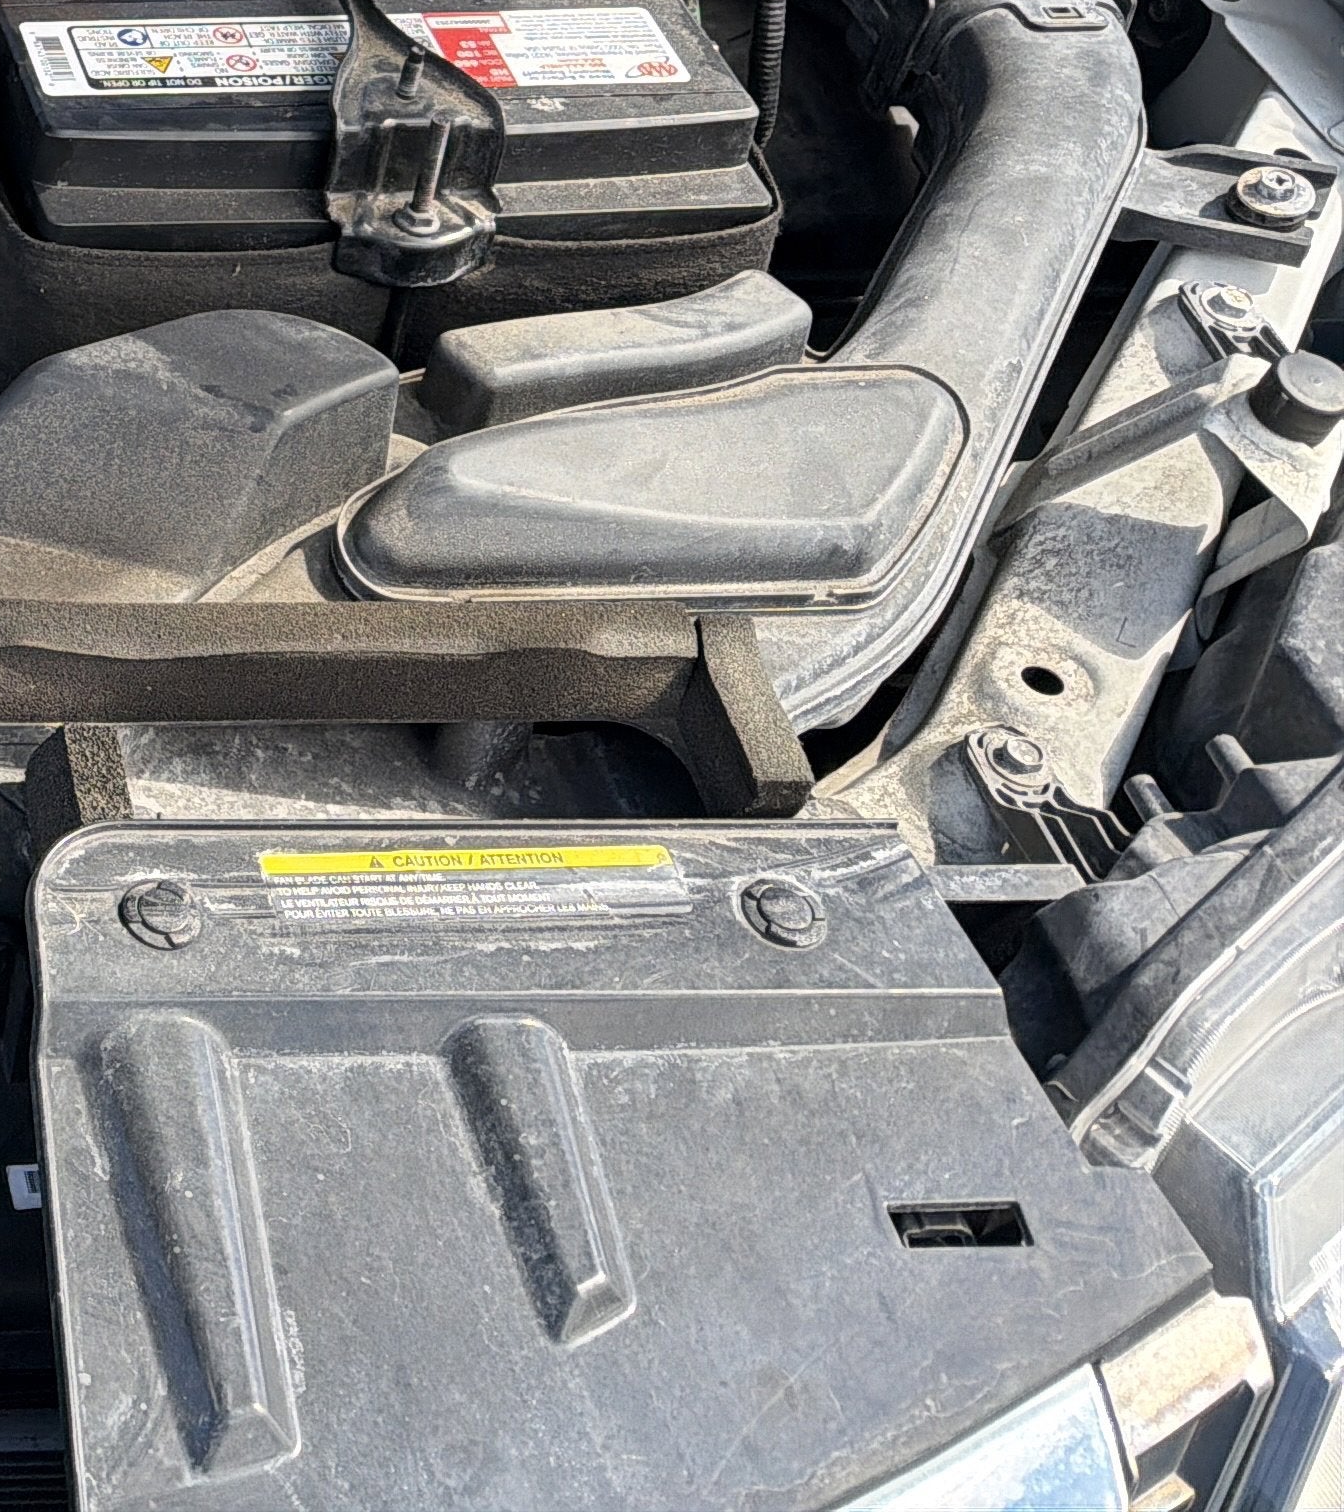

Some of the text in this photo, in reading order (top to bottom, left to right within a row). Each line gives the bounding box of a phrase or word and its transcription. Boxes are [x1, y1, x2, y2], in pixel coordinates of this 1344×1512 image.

[132, 79, 146, 87] OR
[148, 78, 163, 87] TIP
[165, 78, 186, 86] NOT
[186, 78, 202, 86] DO
[392, 854, 462, 867] CAUTION
[480, 851, 564, 866] ATTENTION
[352, 874, 383, 884] START
[278, 887, 292, 897] TO
[320, 885, 351, 895] AVOID
[352, 885, 405, 895] PERSONAL
[467, 882, 504, 892] HANDS
[285, 910, 315, 920] POUR
[351, 908, 384, 918] TOUTE
[456, 905, 477, 915] PAS
